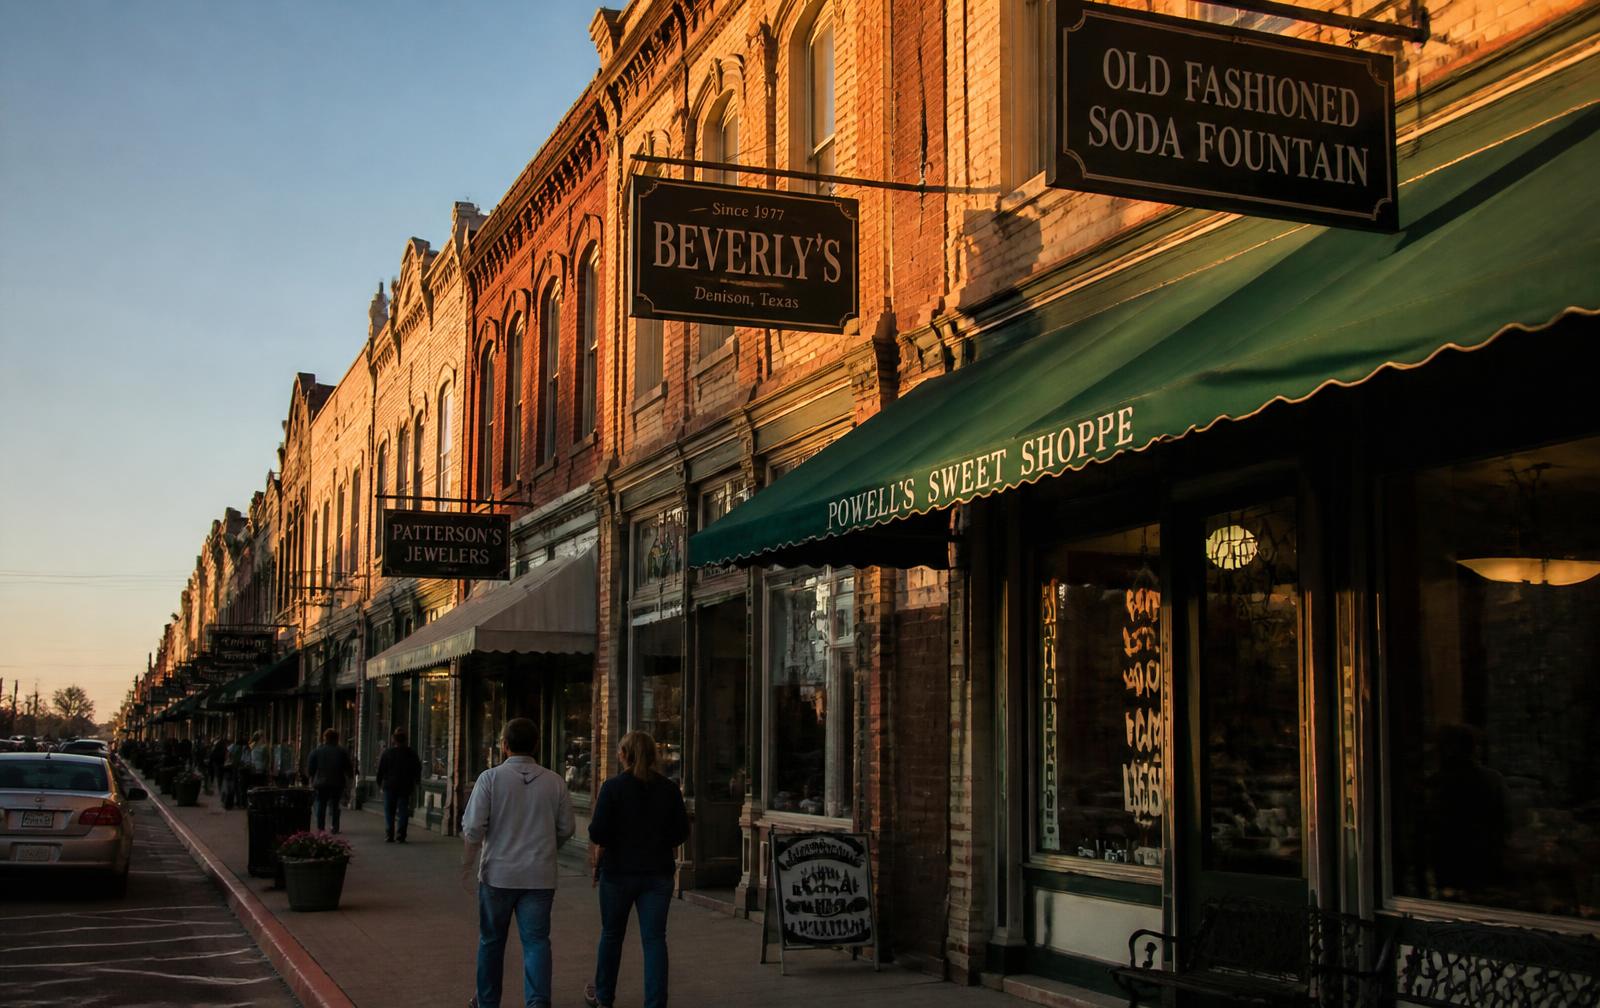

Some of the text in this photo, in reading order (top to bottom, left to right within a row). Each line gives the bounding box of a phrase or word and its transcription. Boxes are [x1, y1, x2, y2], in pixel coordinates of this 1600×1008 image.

[1103, 48, 1360, 128] OLD FASHIONED
[1088, 105, 1369, 187] SODA FOUNTAIN
[712, 202, 784, 221] Since 1977
[653, 221, 841, 283] BEVERLY'S
[695, 286, 799, 308] Denison, Texas
[826, 406, 1133, 530] POWELL'S SWEET SHOPPE
[392, 524, 502, 545] PATTERSON'S
[404, 546, 489, 564] JEWELERS
